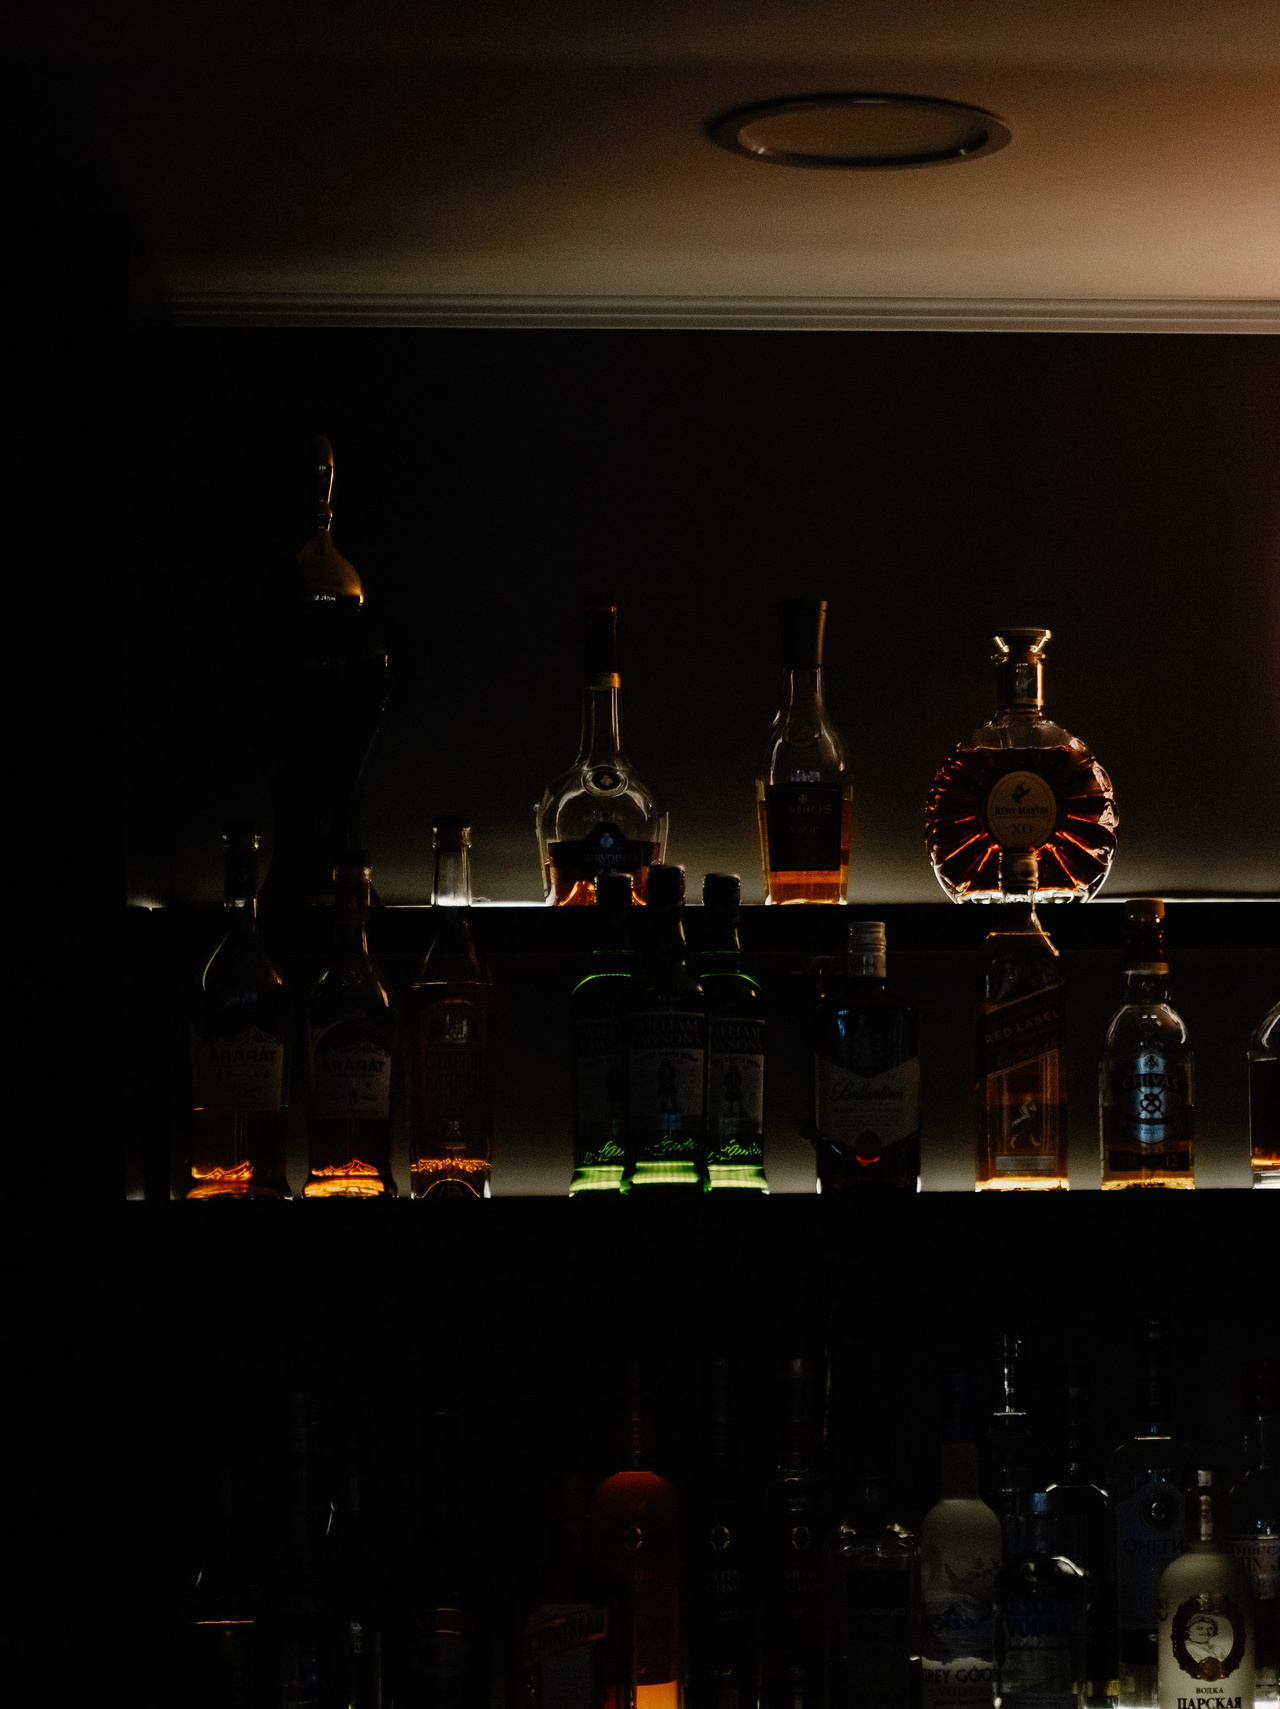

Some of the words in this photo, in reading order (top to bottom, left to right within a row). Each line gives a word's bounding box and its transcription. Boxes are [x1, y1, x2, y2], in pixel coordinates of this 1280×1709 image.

[1012, 824, 1033, 835] XO
[985, 1027, 1013, 1045] RED
[1015, 1009, 1061, 1033] LABEL
[209, 1049, 277, 1063] ARARAT
[322, 1059, 386, 1074] ARARAT
[1122, 1074, 1178, 1089] CHIVAS
[1166, 1155, 1178, 1168] 12
[1123, 1537, 1185, 1555] ОНЕГИ
[922, 1668, 951, 1683] GREY
[956, 1667, 993, 1683] GOO
[1195, 1687, 1224, 1696] ВОДКА
